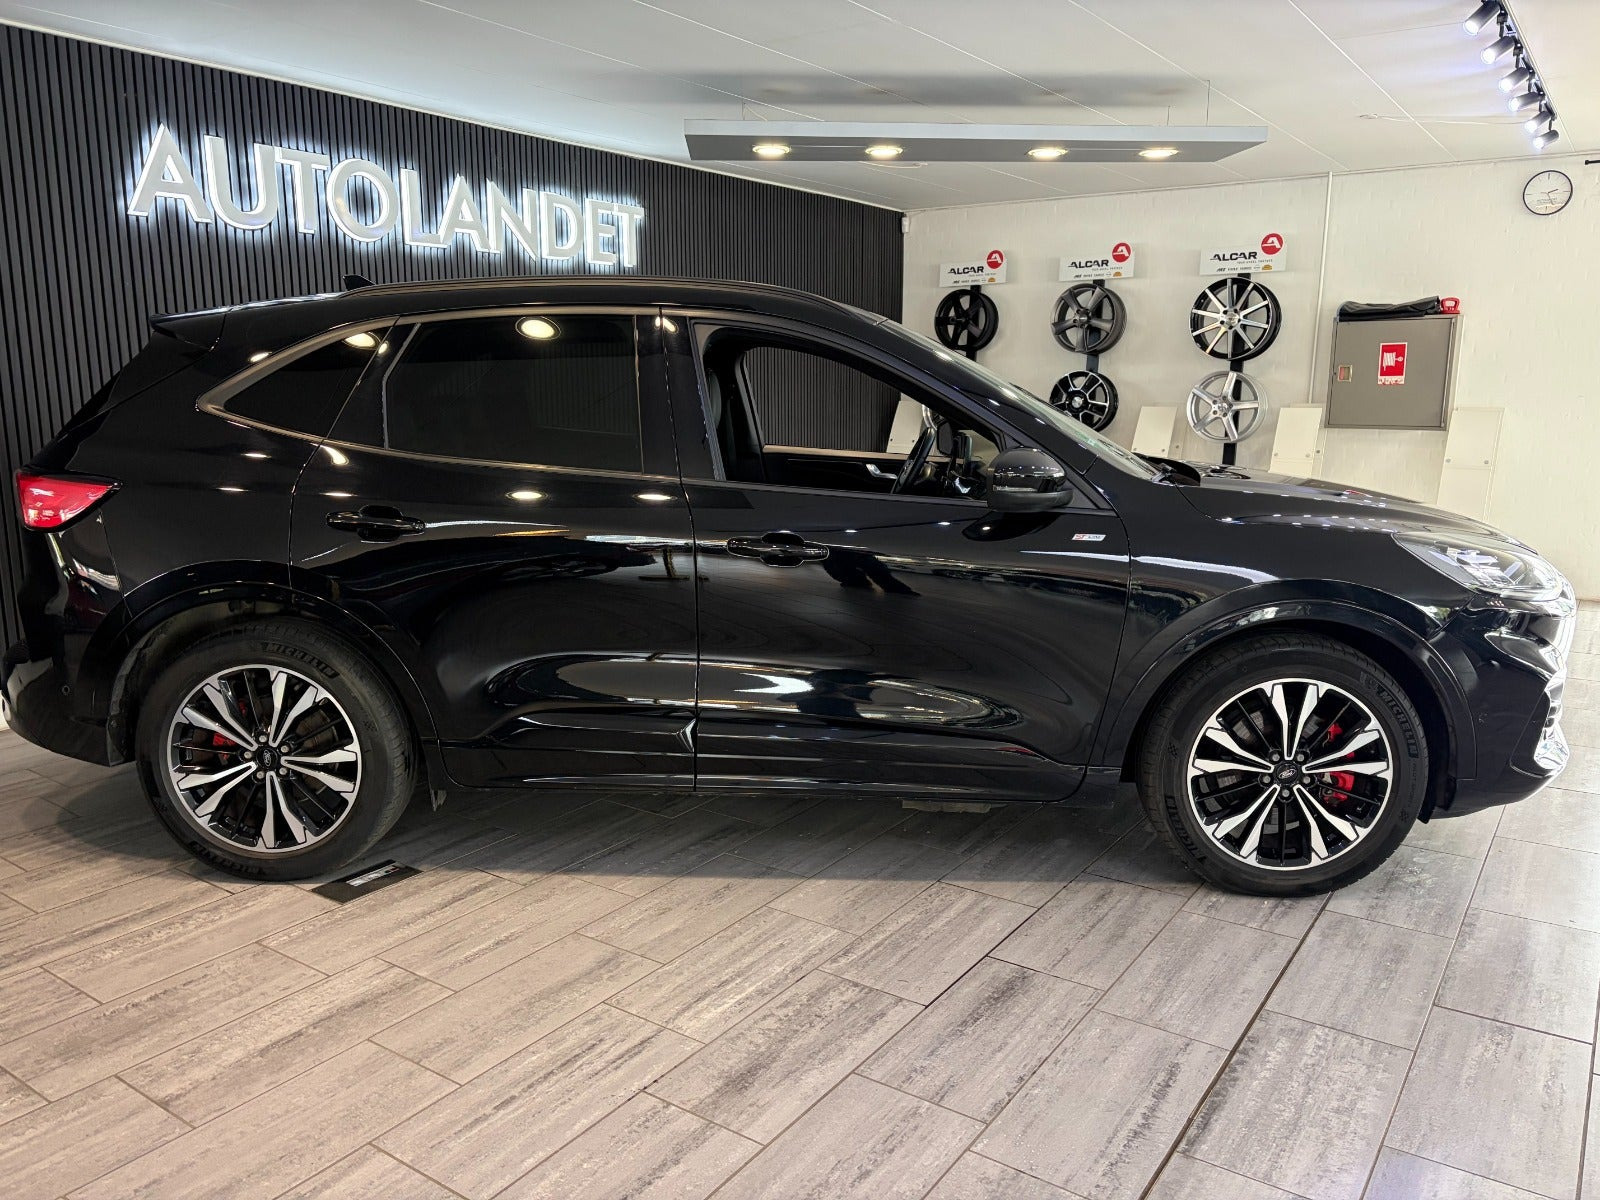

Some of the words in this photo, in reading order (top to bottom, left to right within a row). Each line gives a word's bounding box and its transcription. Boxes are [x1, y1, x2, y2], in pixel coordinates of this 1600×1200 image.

[128, 123, 645, 268] AUTOLANDET
[1210, 252, 1258, 261] ALCAR
[1068, 260, 1109, 269] ALCAR
[948, 266, 985, 275] ALCAR
[1379, 685, 1419, 758] MICHELIN
